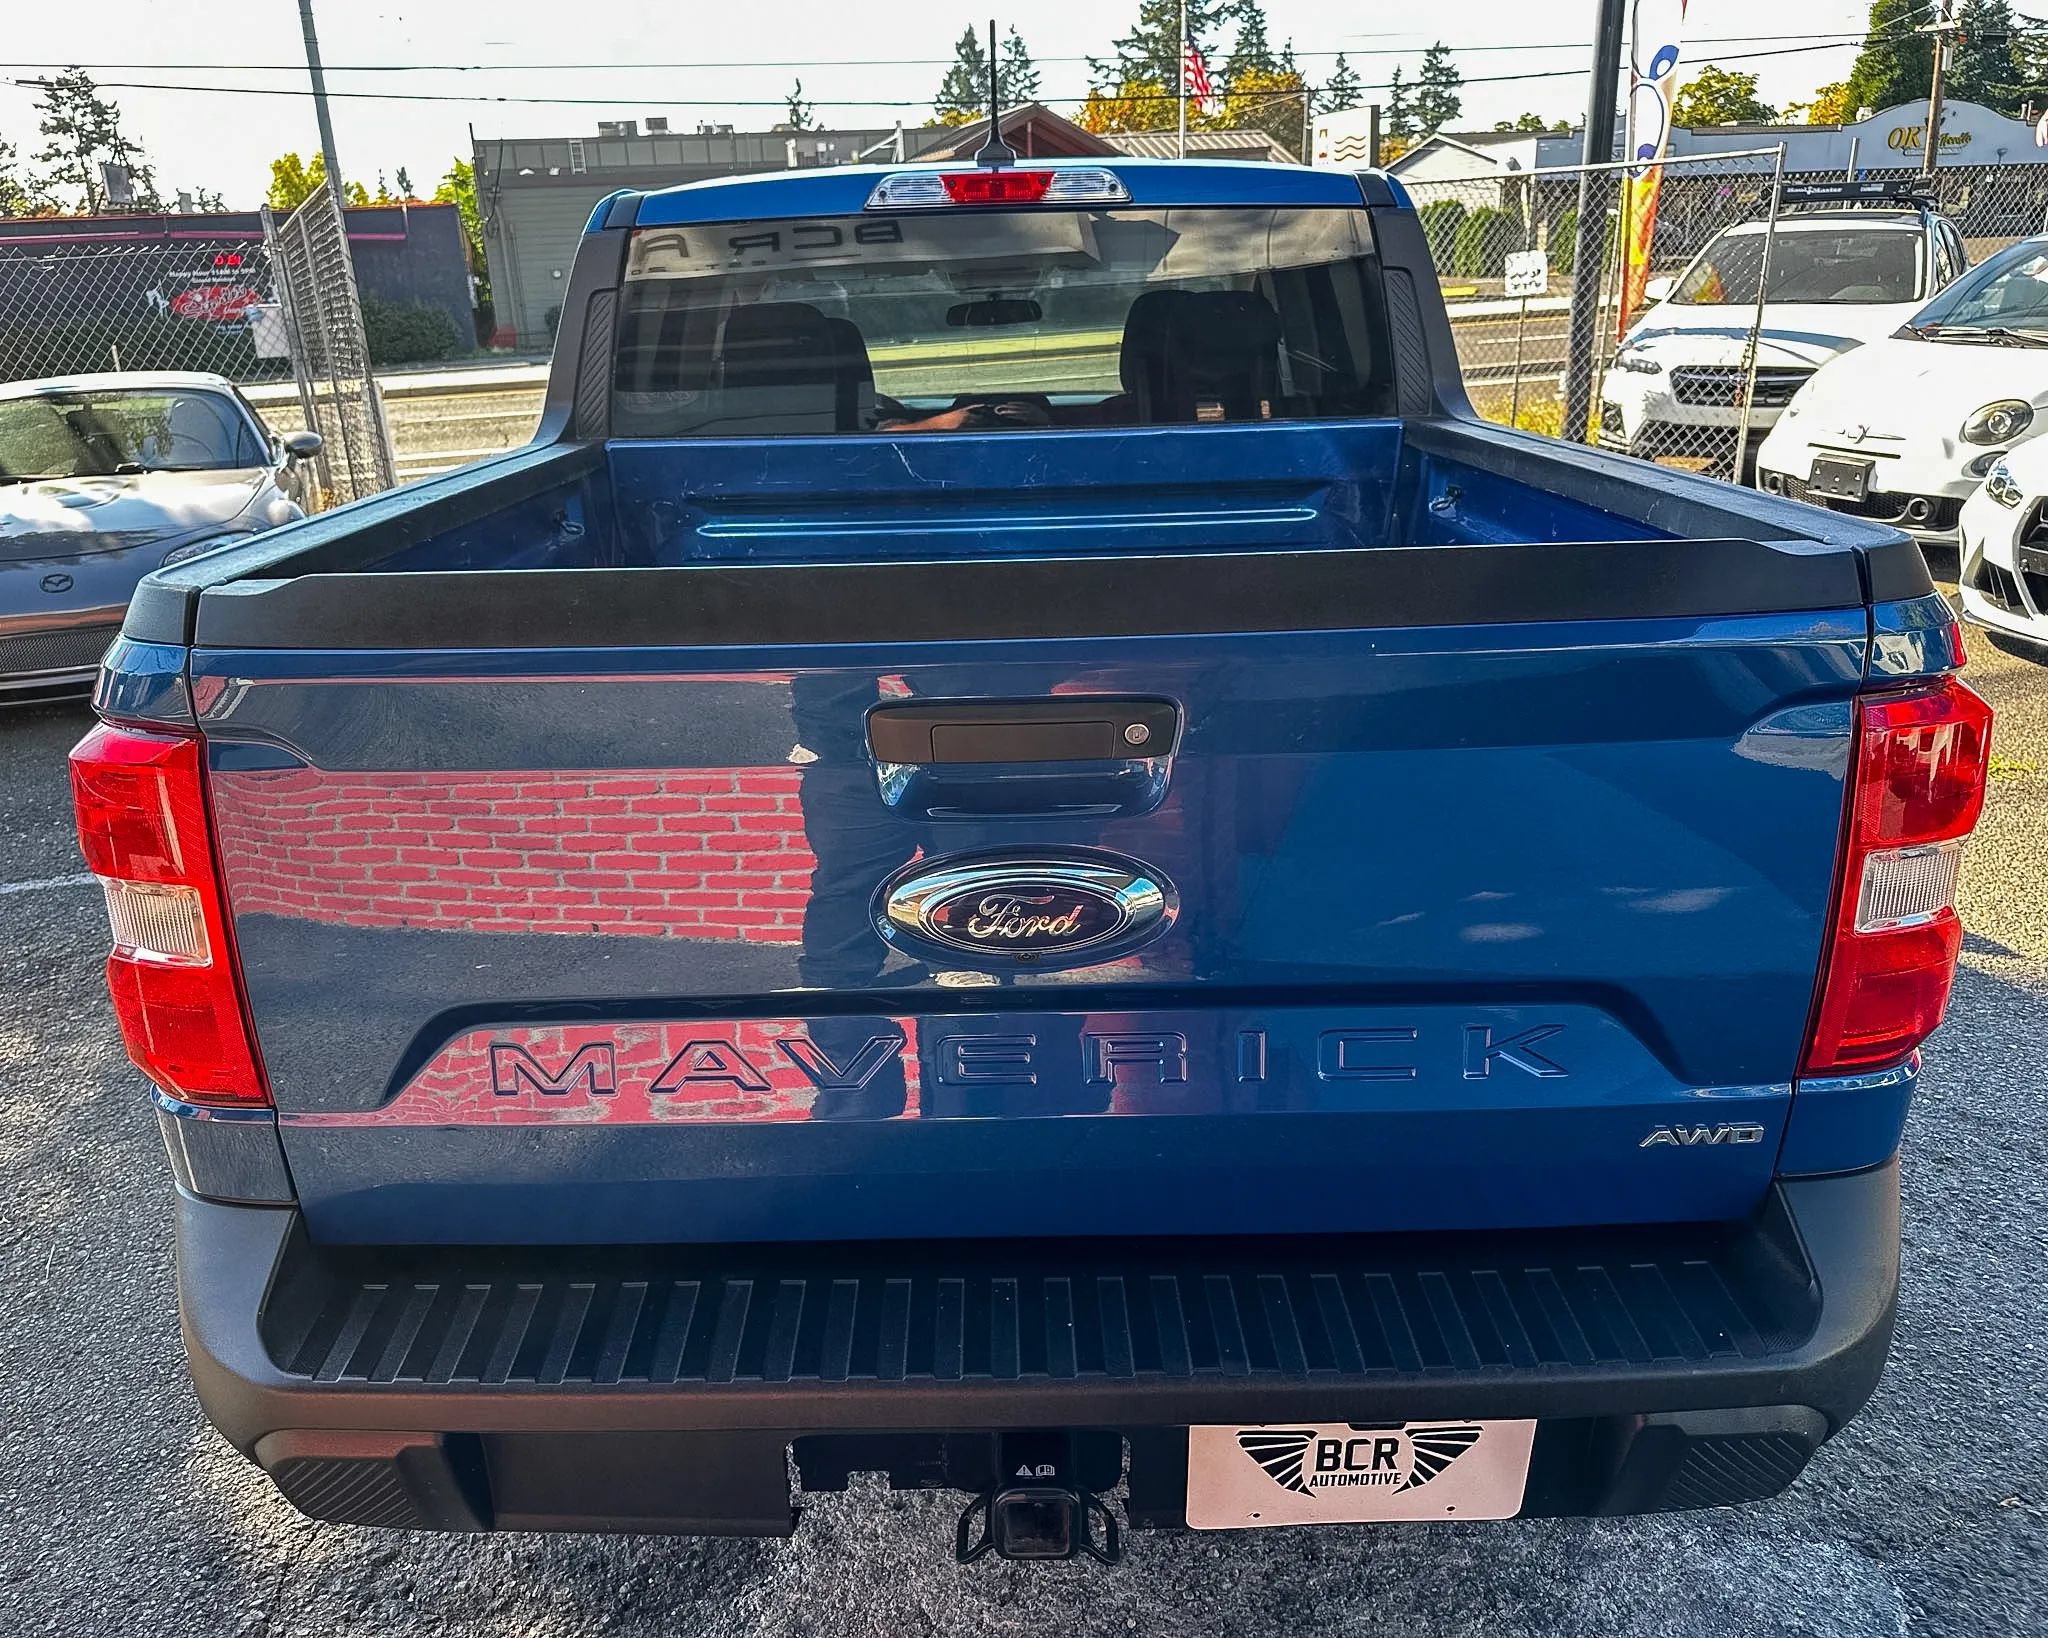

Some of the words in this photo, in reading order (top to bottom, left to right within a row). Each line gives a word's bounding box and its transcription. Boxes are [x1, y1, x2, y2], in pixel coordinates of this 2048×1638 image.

[1888, 125, 1921, 150] OK
[214, 254, 242, 266] OEN
[967, 893, 1084, 939] Ford
[490, 1022, 1569, 1096] MAVERICK
[1639, 1122, 1764, 1147] AWD
[1315, 1437, 1400, 1472] BCR
[1309, 1472, 1402, 1487] AUTOMOTIVE
